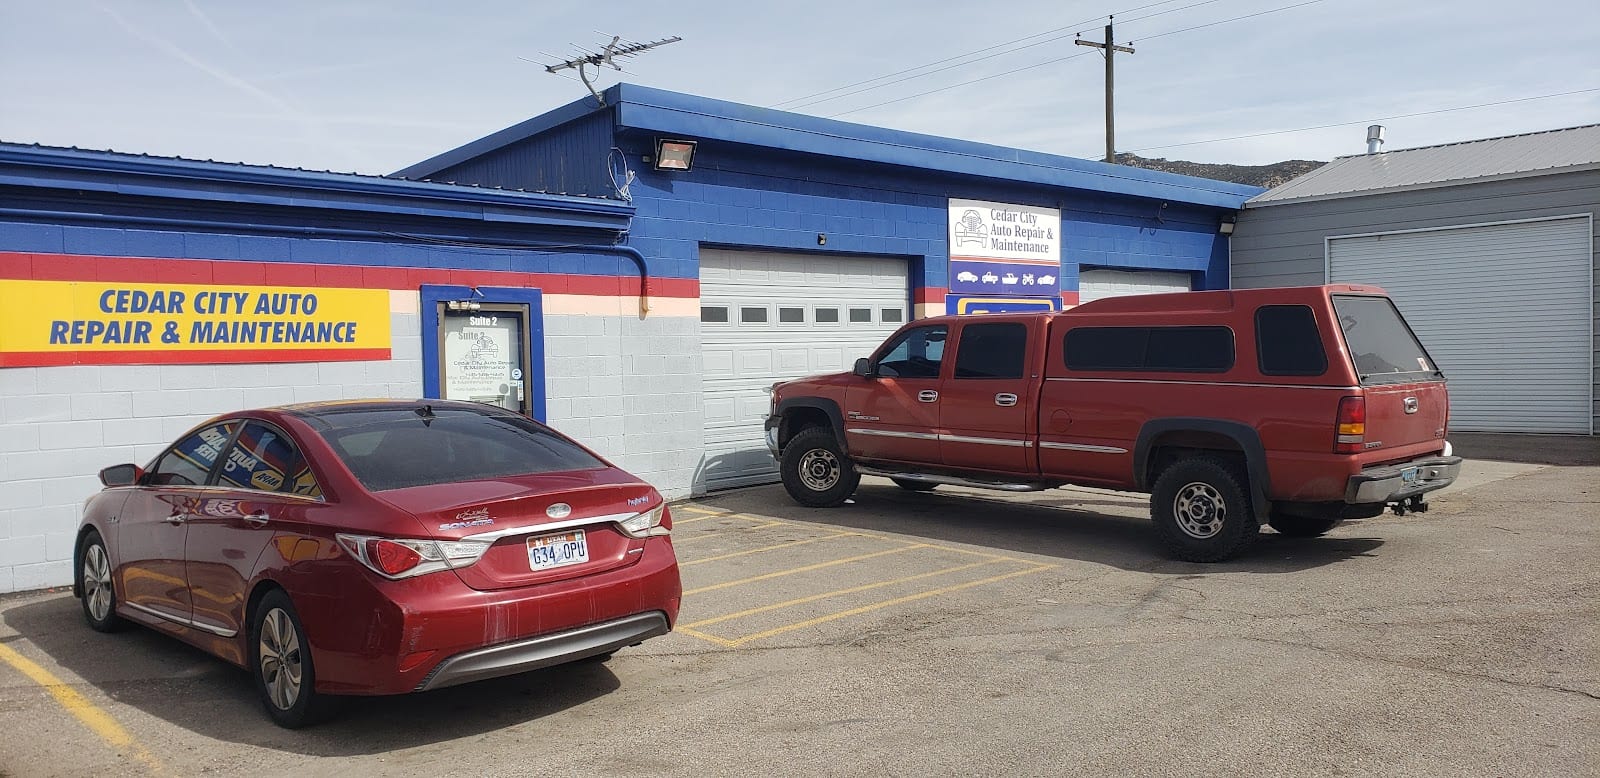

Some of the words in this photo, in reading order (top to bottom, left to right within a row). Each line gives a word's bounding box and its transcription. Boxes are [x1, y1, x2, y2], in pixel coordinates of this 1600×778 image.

[990, 208, 1017, 222] Cedar
[1020, 211, 1038, 227] City
[990, 224, 1012, 237] Auto
[1014, 225, 1045, 241] Repair
[1047, 228, 1053, 240] &
[991, 238, 1049, 253] Maintenance
[99, 289, 185, 314] CEDAR
[193, 292, 249, 314] CITY
[254, 293, 318, 315] AUTO
[469, 316, 491, 326] Suite
[492, 316, 498, 326] 2
[50, 320, 153, 344] REPAIR
[161, 321, 181, 344] &
[190, 321, 357, 344] MAINTENANCE
[533, 546, 556, 565] G34
